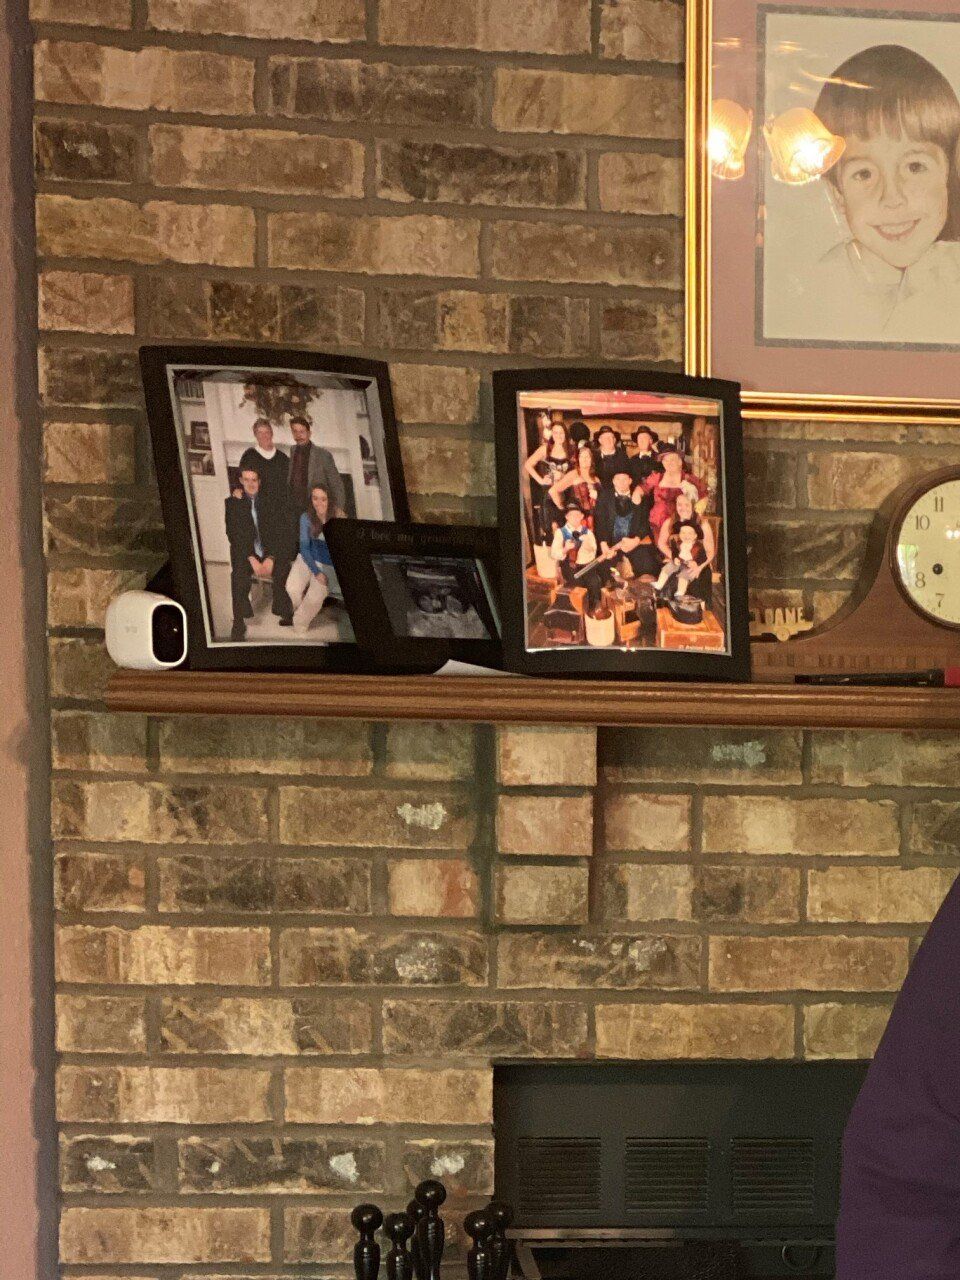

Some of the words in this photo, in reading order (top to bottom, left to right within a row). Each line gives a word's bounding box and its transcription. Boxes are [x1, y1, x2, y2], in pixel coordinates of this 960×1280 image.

[934, 496, 944, 512] 11
[915, 515, 930, 530] 10
[915, 571, 926, 588] 8
[935, 593, 945, 608] 7
